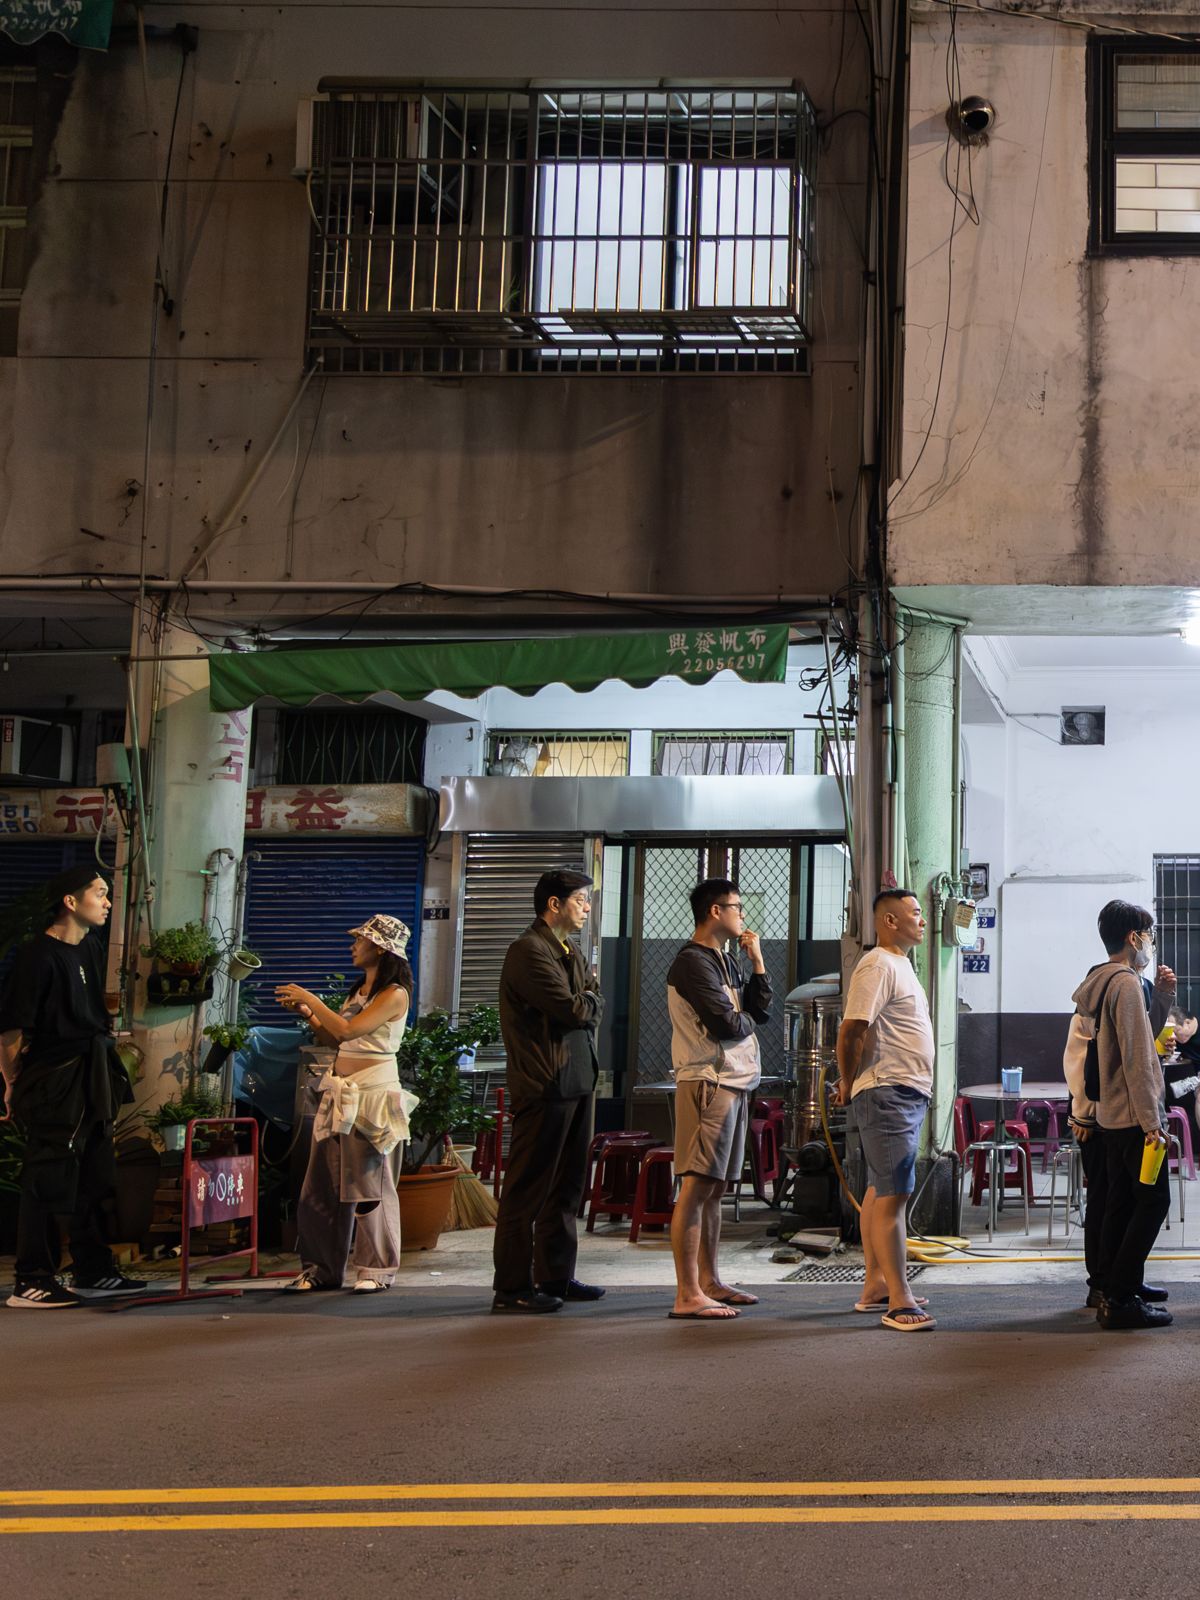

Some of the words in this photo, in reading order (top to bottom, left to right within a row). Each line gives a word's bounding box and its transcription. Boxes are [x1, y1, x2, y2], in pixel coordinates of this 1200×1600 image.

[666, 628, 767, 656] 興發帆布
[972, 960, 986, 971] 22
